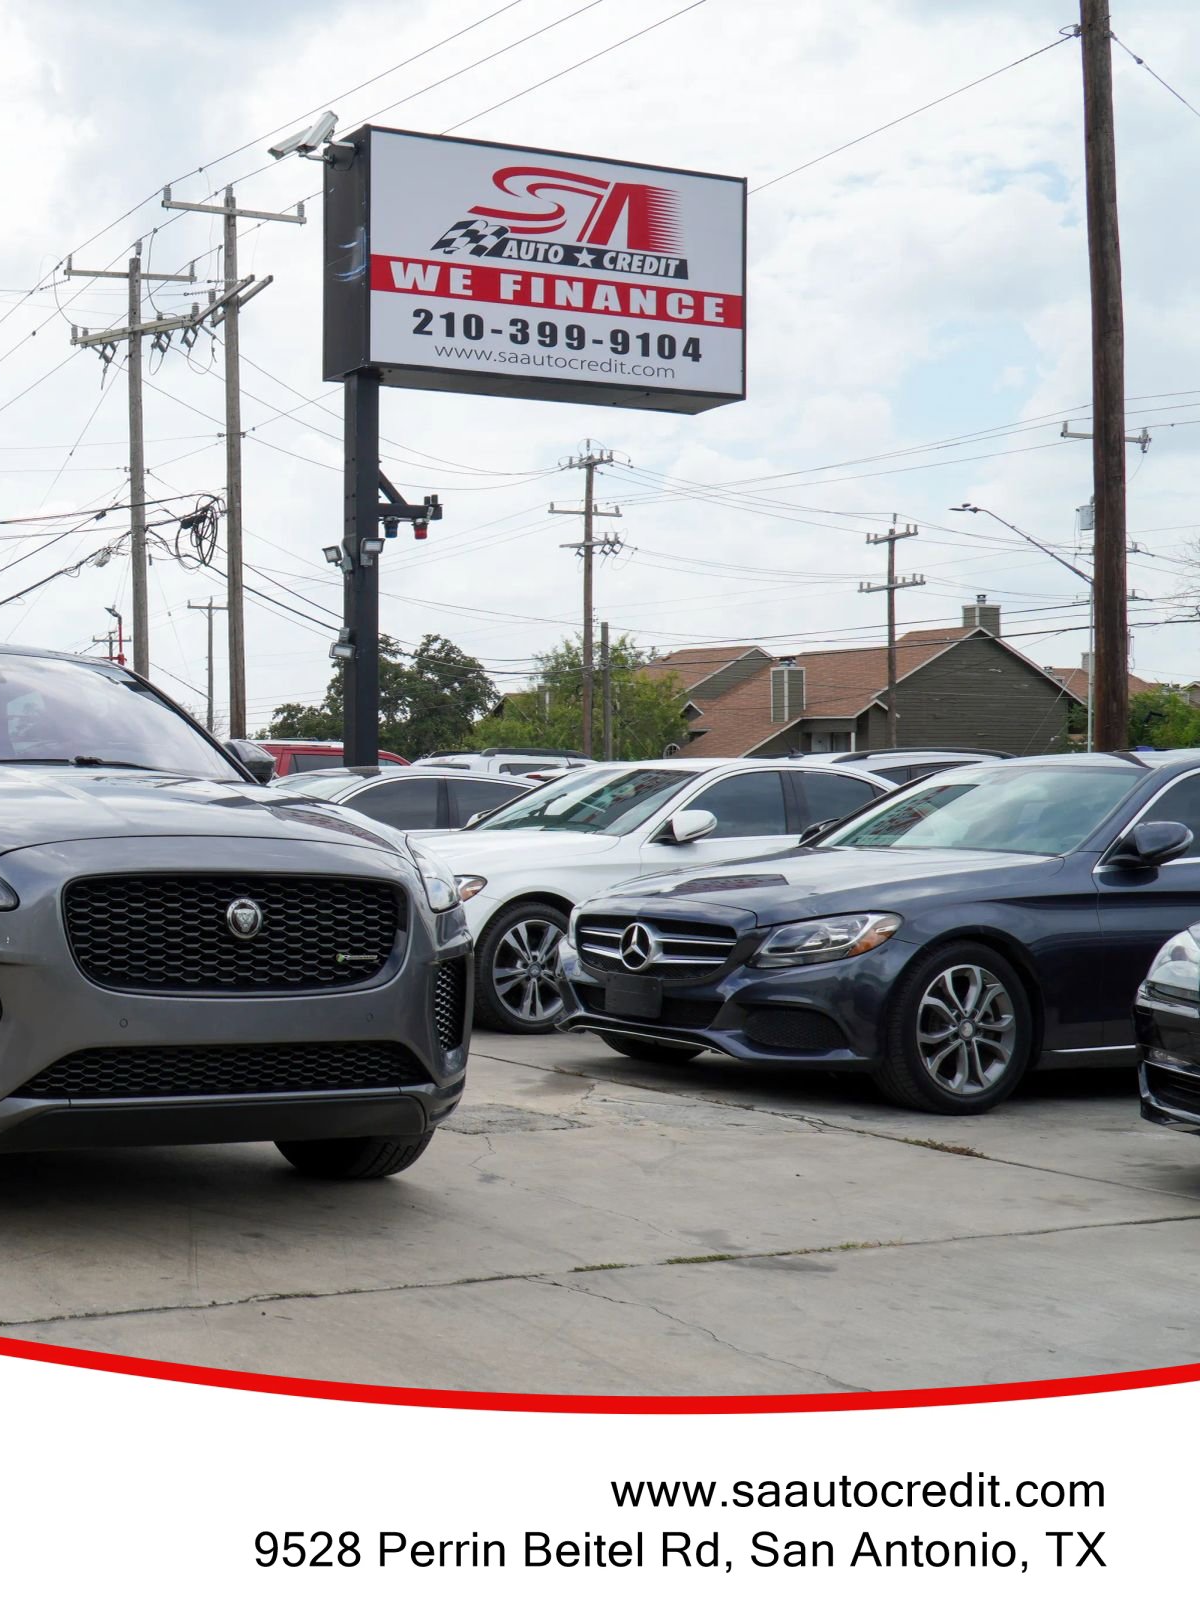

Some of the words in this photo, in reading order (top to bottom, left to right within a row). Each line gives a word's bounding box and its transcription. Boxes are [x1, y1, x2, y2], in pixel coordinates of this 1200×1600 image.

[501, 239, 565, 264] AUTO
[602, 251, 681, 278] CREDIT
[390, 261, 473, 296] WE
[499, 272, 725, 323] FINANCE
[412, 308, 702, 363] 210-399-9104
[434, 345, 676, 379] www.saautocredit.com
